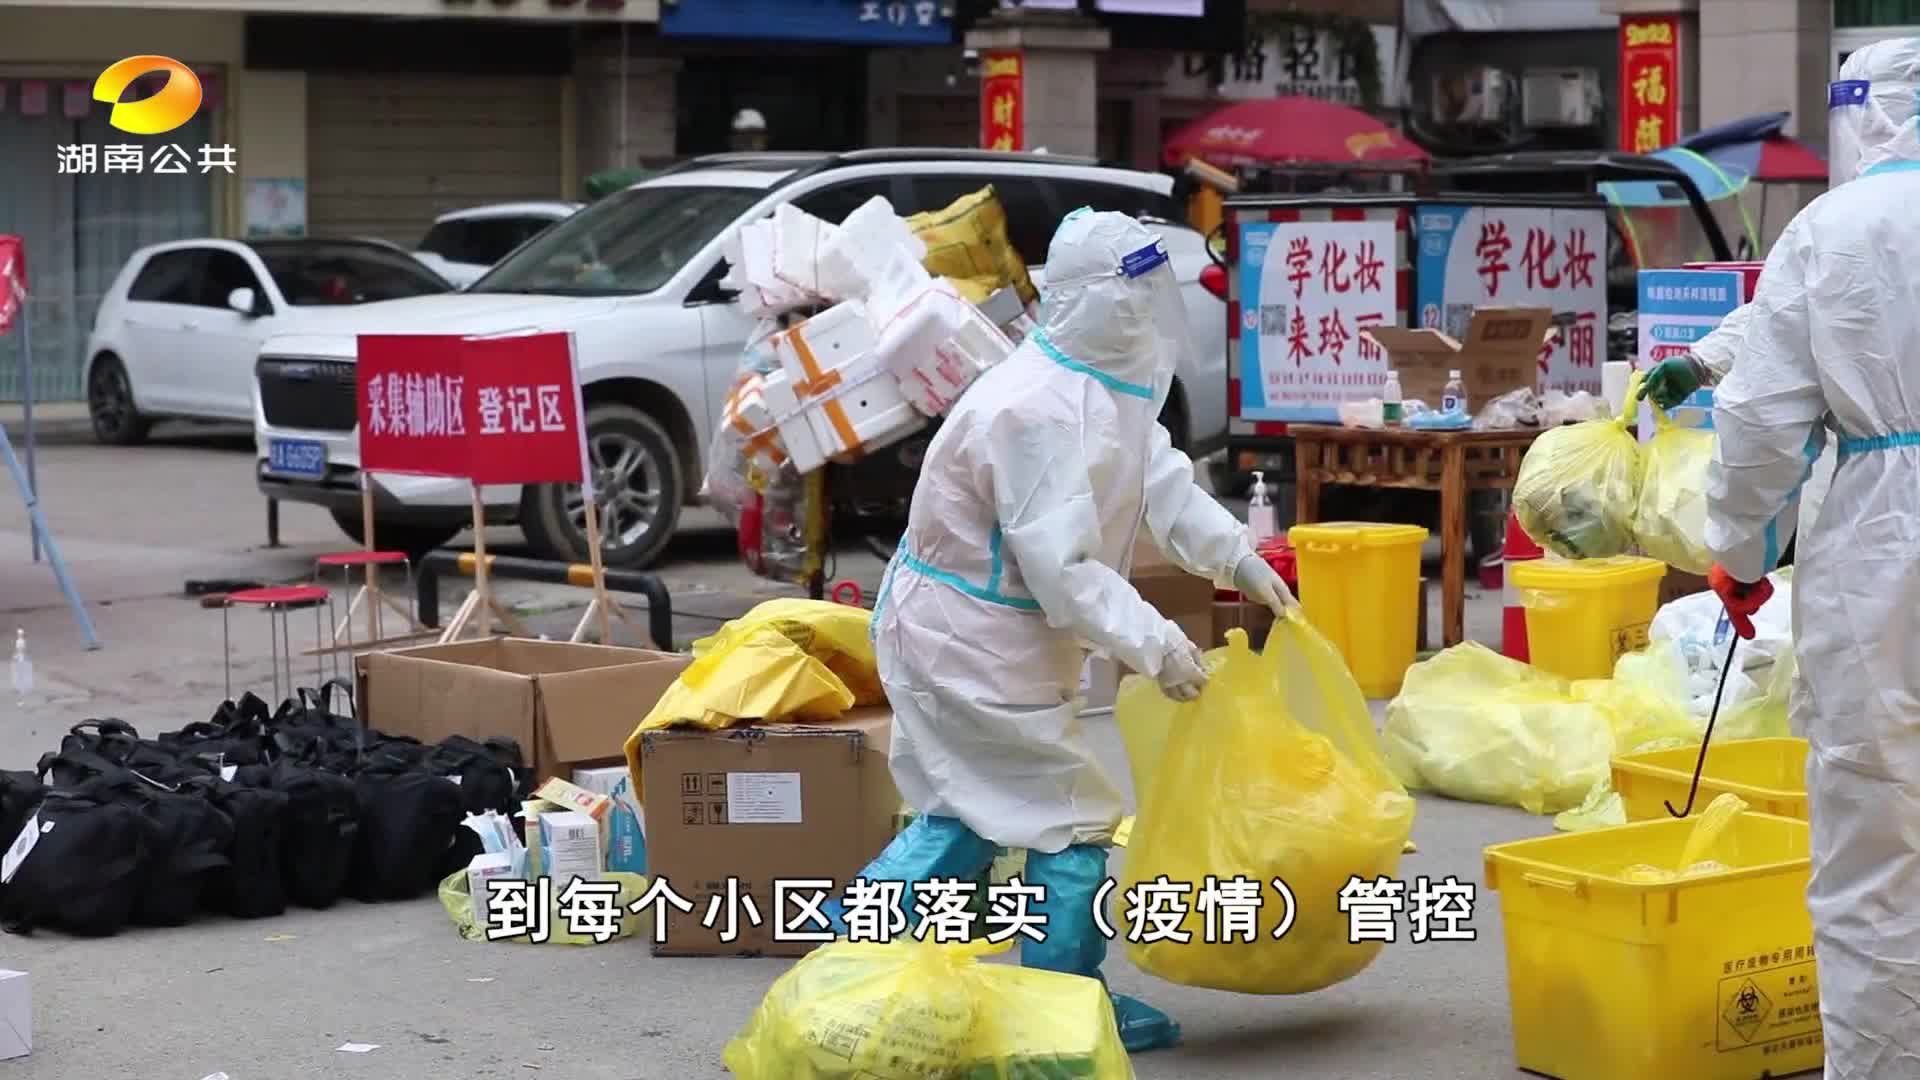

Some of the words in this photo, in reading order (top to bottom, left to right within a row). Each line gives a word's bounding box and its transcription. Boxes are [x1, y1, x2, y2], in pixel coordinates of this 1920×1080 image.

[1285, 236, 1385, 300] 学化妆
[1475, 217, 1597, 298] 学化妆
[367, 372, 466, 437] 采集辅助区
[478, 384, 567, 434] 登记区
